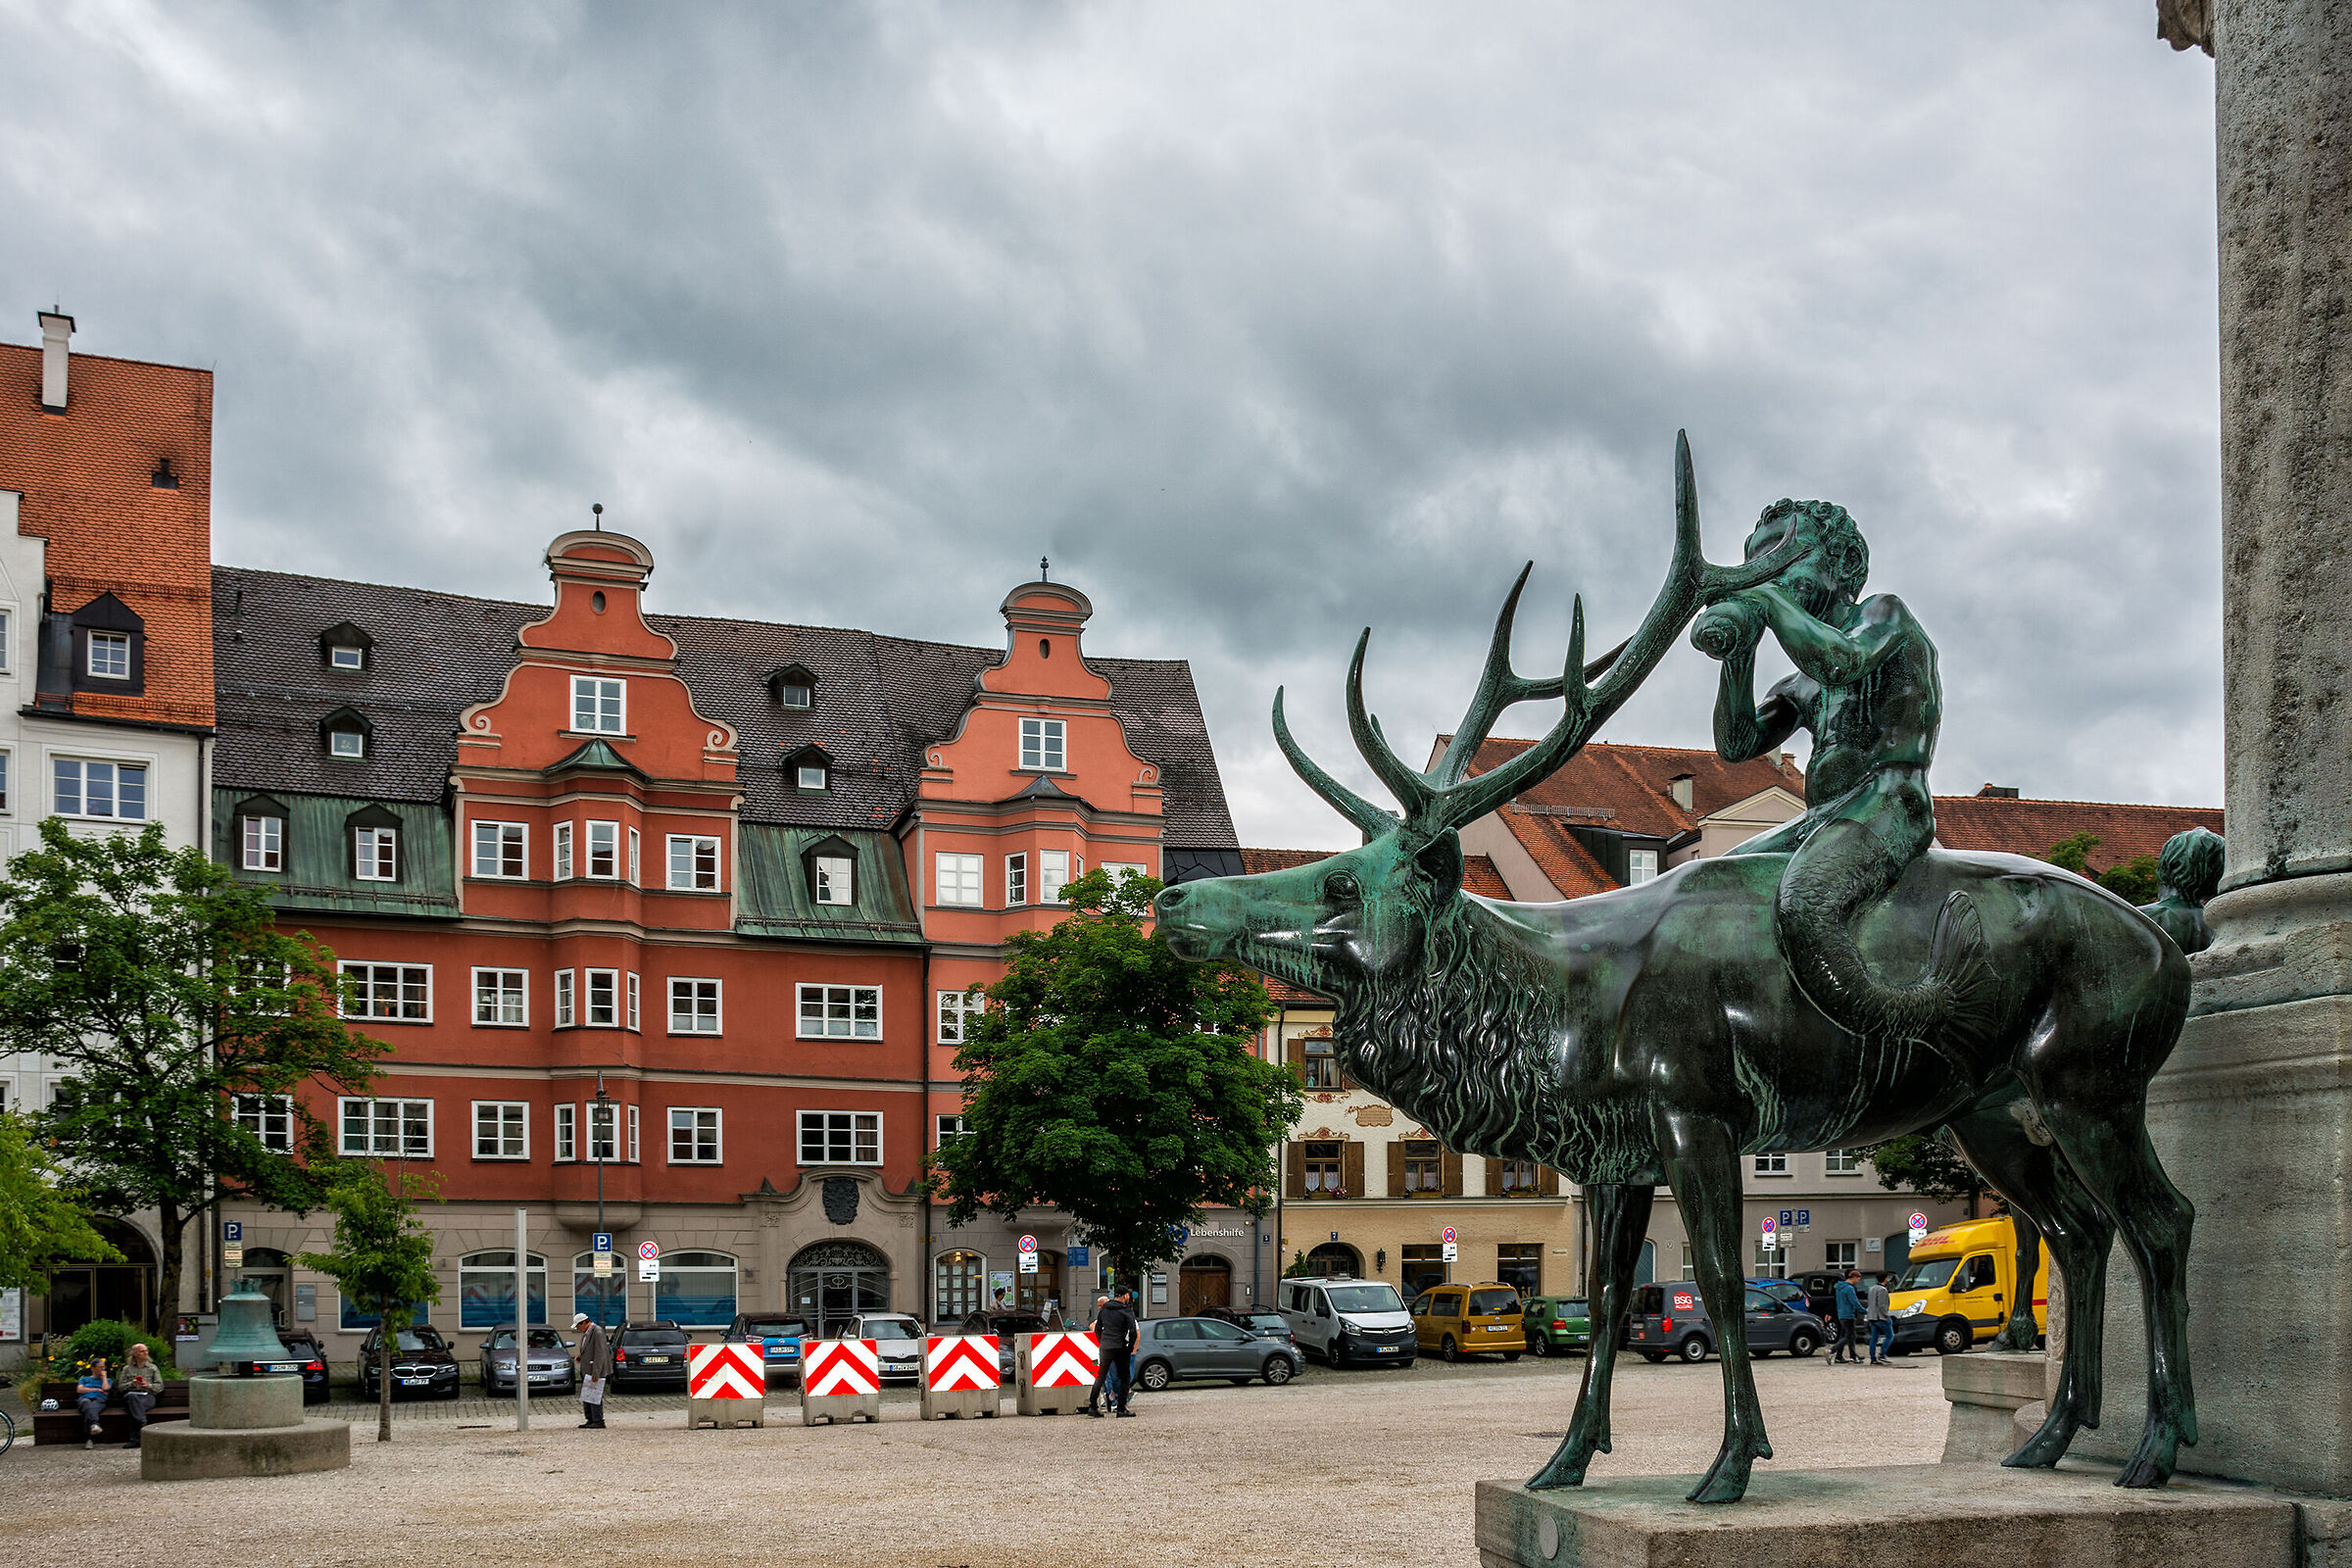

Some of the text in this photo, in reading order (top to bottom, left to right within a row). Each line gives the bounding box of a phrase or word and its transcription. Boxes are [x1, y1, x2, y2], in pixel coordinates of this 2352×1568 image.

[1783, 1212, 1789, 1224] P
[1800, 1211, 1807, 1223] P
[227, 1224, 238, 1239] P
[1190, 1227, 1245, 1237] Lebenshilfe
[597, 1236, 608, 1250] P
[1674, 1296, 1692, 1304] BSG
